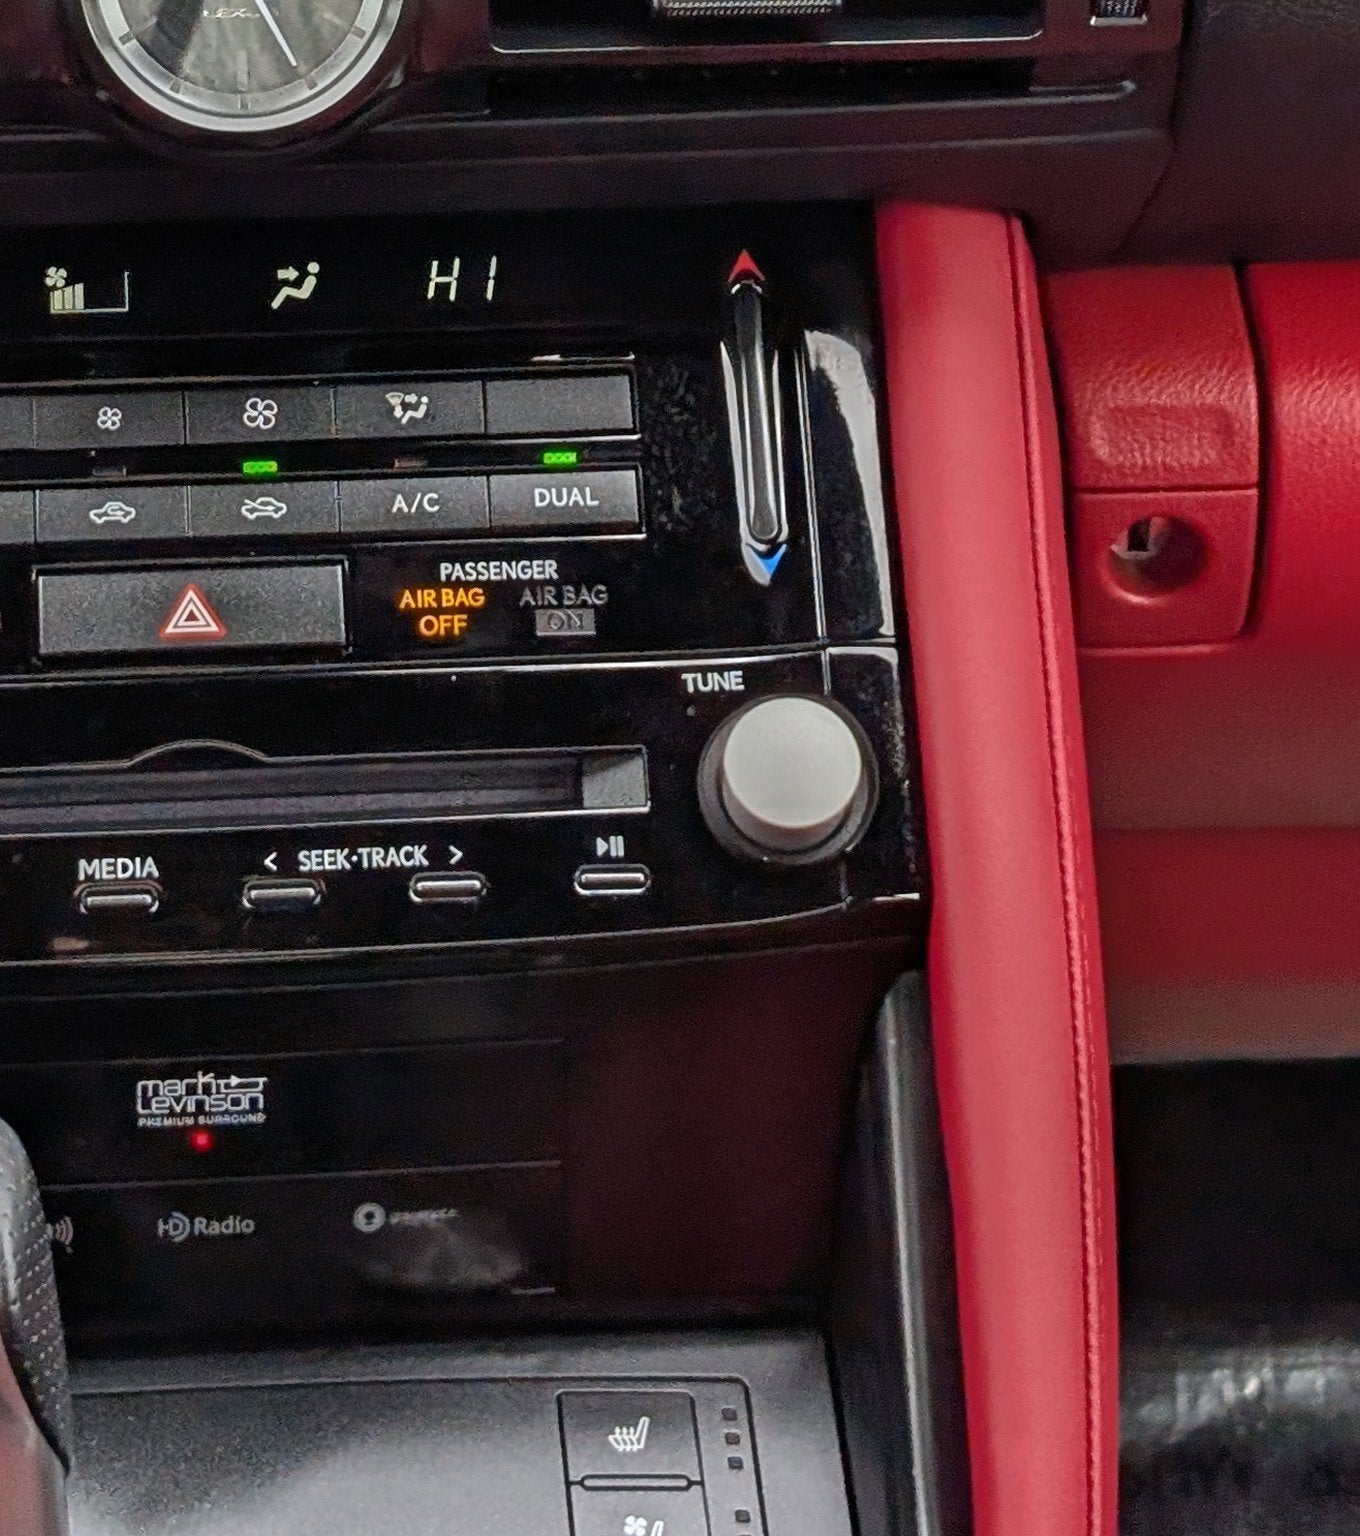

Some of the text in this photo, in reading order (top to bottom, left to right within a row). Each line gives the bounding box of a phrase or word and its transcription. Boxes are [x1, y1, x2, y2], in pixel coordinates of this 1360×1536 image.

[391, 491, 440, 514] A/C
[534, 486, 600, 508] DUAL
[439, 558, 559, 583] PASSENGER
[398, 587, 486, 609] AIR BAG
[518, 583, 609, 608] AIR BAG
[418, 613, 469, 637] OFF
[679, 670, 746, 694] TUNE
[78, 855, 161, 882] MEDIA
[193, 1215, 256, 1236] Radio
